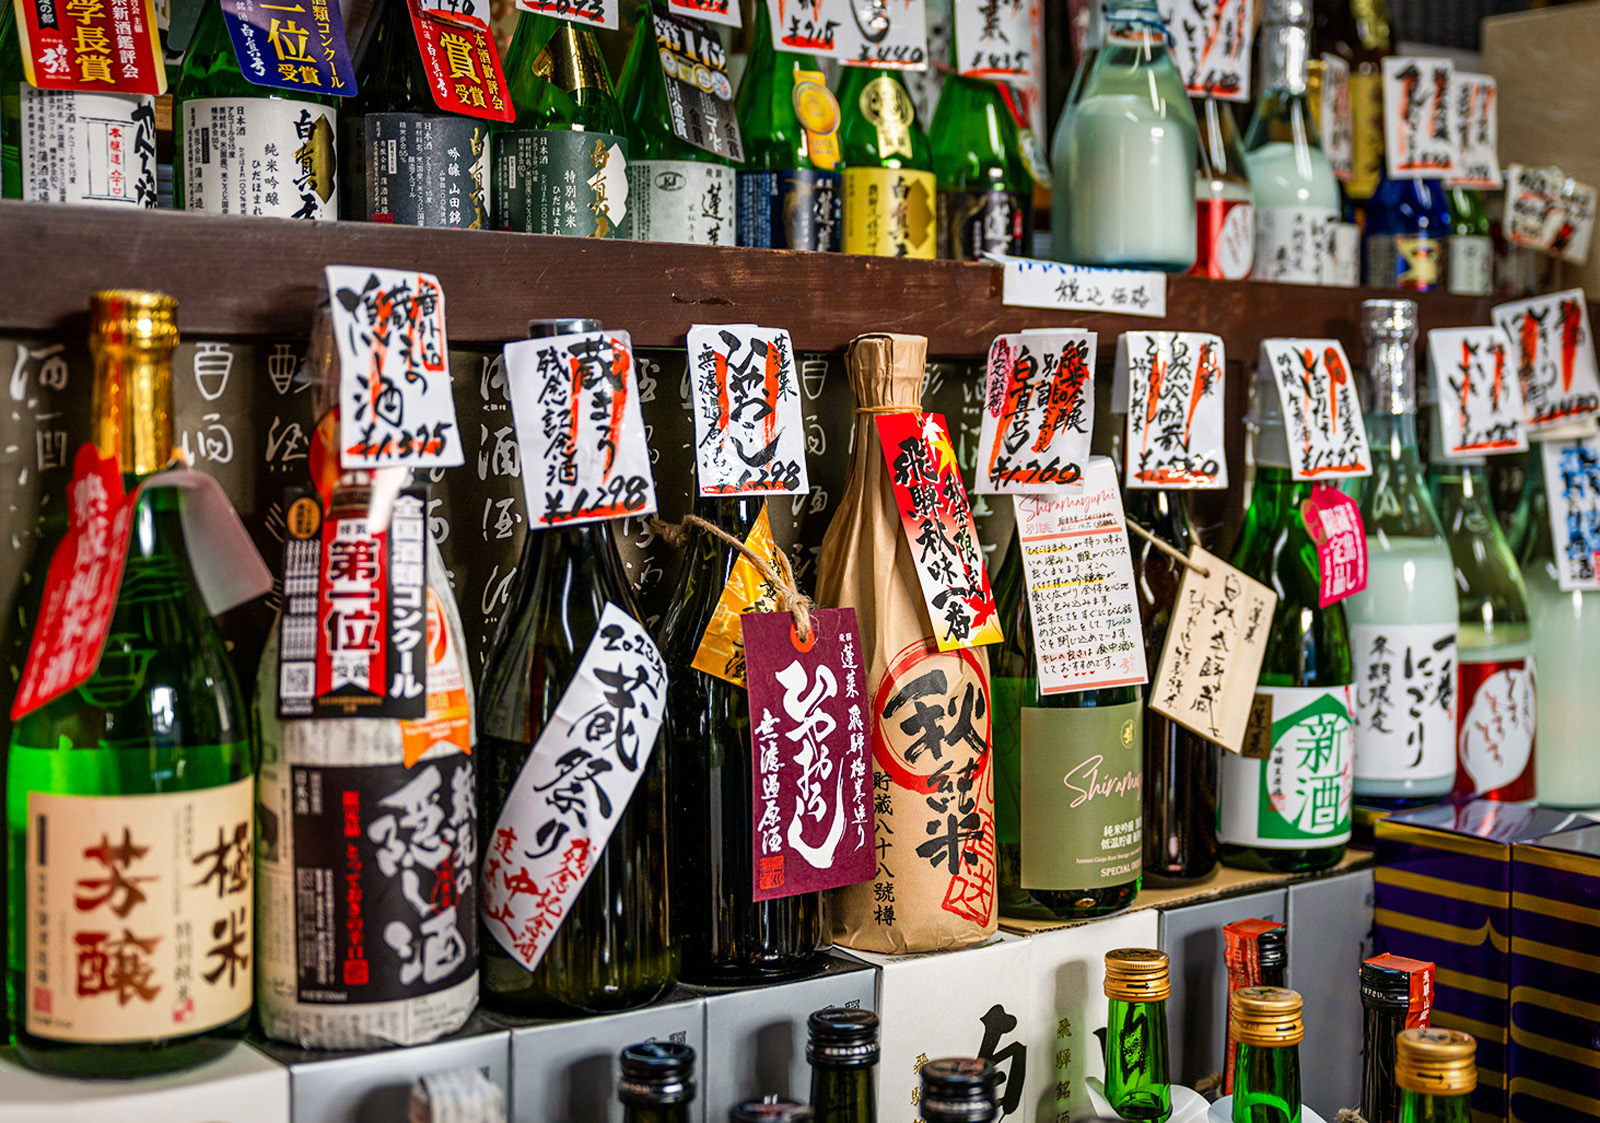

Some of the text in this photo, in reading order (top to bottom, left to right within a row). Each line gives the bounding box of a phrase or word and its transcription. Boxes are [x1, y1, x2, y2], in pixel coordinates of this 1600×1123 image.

[240, 23, 266, 76] 白真弓
[277, 63, 322, 86] 受賞
[236, 106, 246, 136] 日本酒
[455, 84, 488, 108] 受賞
[109, 127, 124, 195] 本醸造 辛口
[424, 121, 433, 151] 日本酒
[540, 136, 549, 165] 日本酒
[251, 159, 263, 216] ひだほまれ
[264, 143, 280, 206] 純米吟醸
[449, 182, 461, 225] 山田錦
[563, 169, 578, 229] 特別純米
[1055, 278, 1151, 309] 税込価格
[892, 436, 973, 643] 飛騨秋味一番
[324, 538, 380, 656] 第一位
[839, 643, 860, 699] 蓬莱
[1369, 634, 1394, 735] 冬期限定
[883, 668, 989, 764] 秋
[1404, 645, 1436, 769] にごり
[775, 659, 846, 870] ひやおろし
[1296, 713, 1348, 831] 新酒
[915, 757, 985, 876] 純米
[873, 771, 897, 928] 貯蔵八十八號樽
[1101, 863, 1132, 877] SPECIAL
